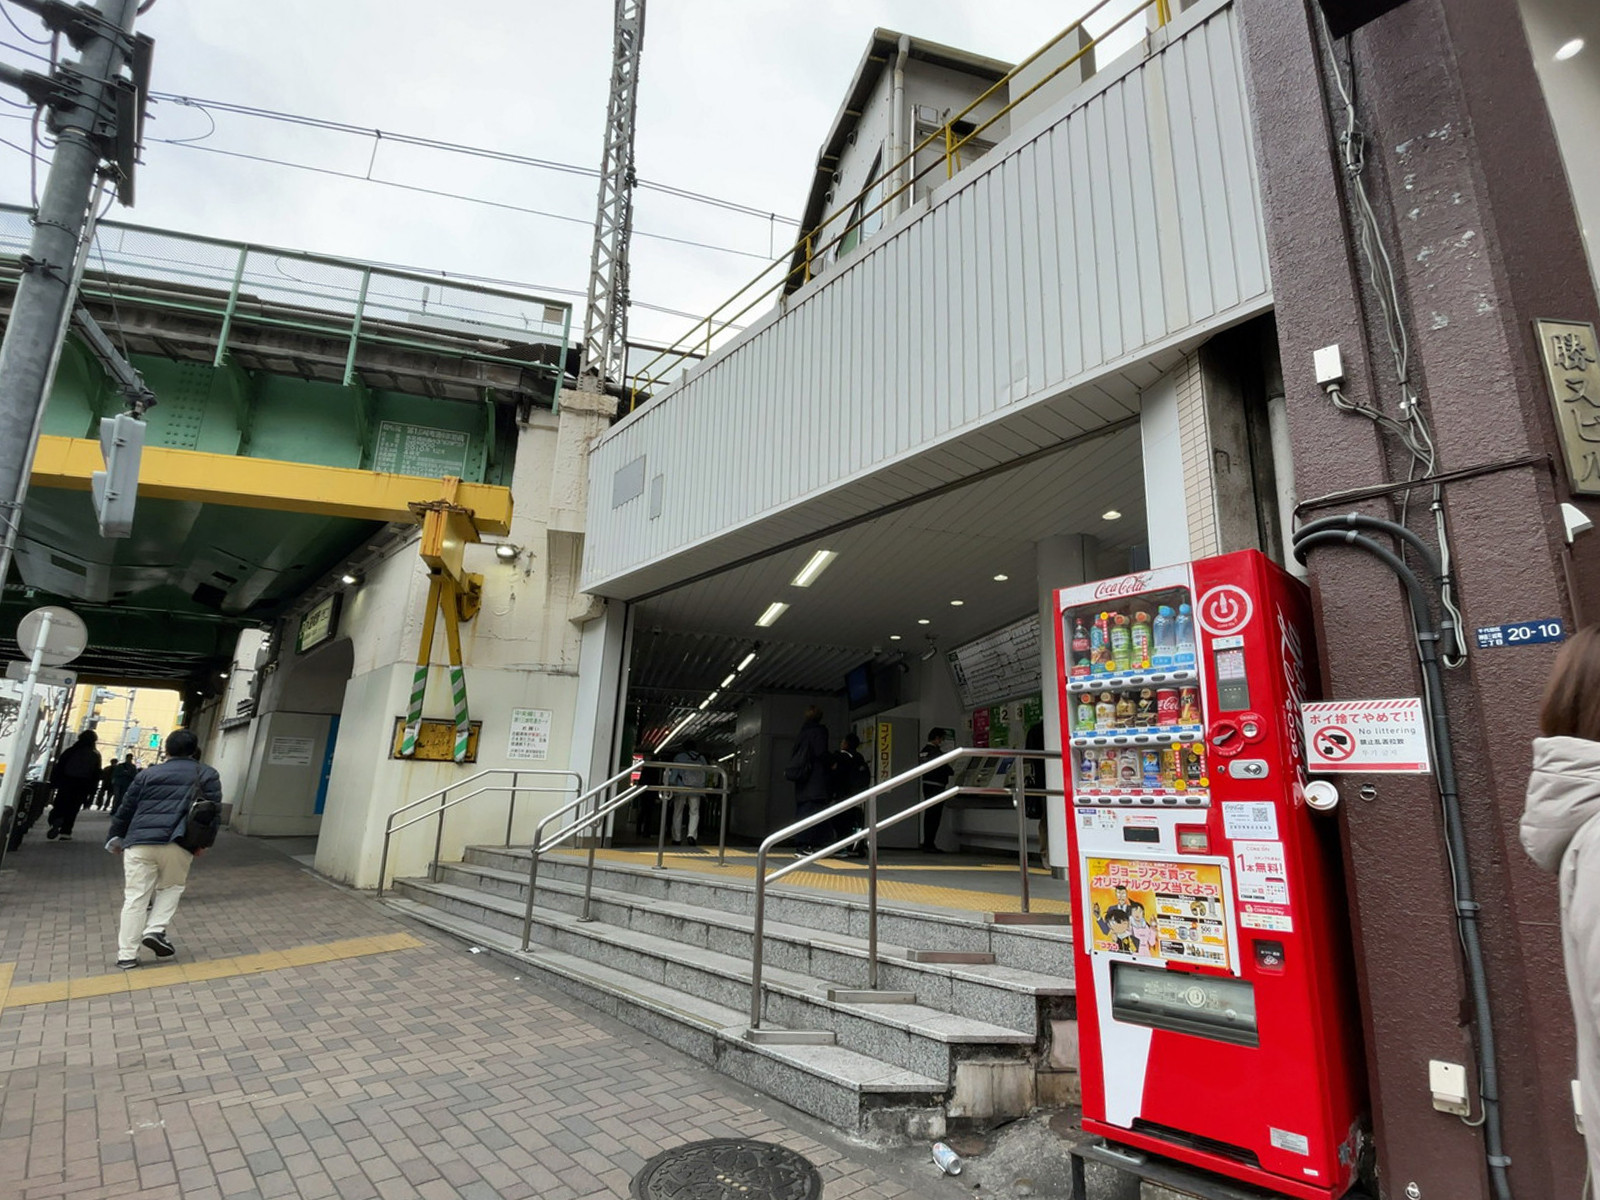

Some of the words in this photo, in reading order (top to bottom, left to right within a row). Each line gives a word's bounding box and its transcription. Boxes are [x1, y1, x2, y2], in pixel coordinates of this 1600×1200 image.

[1095, 575, 1153, 600] Coca-Cola
[1507, 623, 1561, 641] 20-10
[1001, 709, 1008, 721] 2
[1358, 727, 1372, 735] No
[1374, 727, 1417, 736] littering
[880, 724, 890, 780] コインロッカ
[1110, 865, 1196, 882] ジョージアを買って
[1237, 853, 1284, 875] 1本無料!
[1093, 876, 1218, 896] オリジナルグッズ当てよう!
